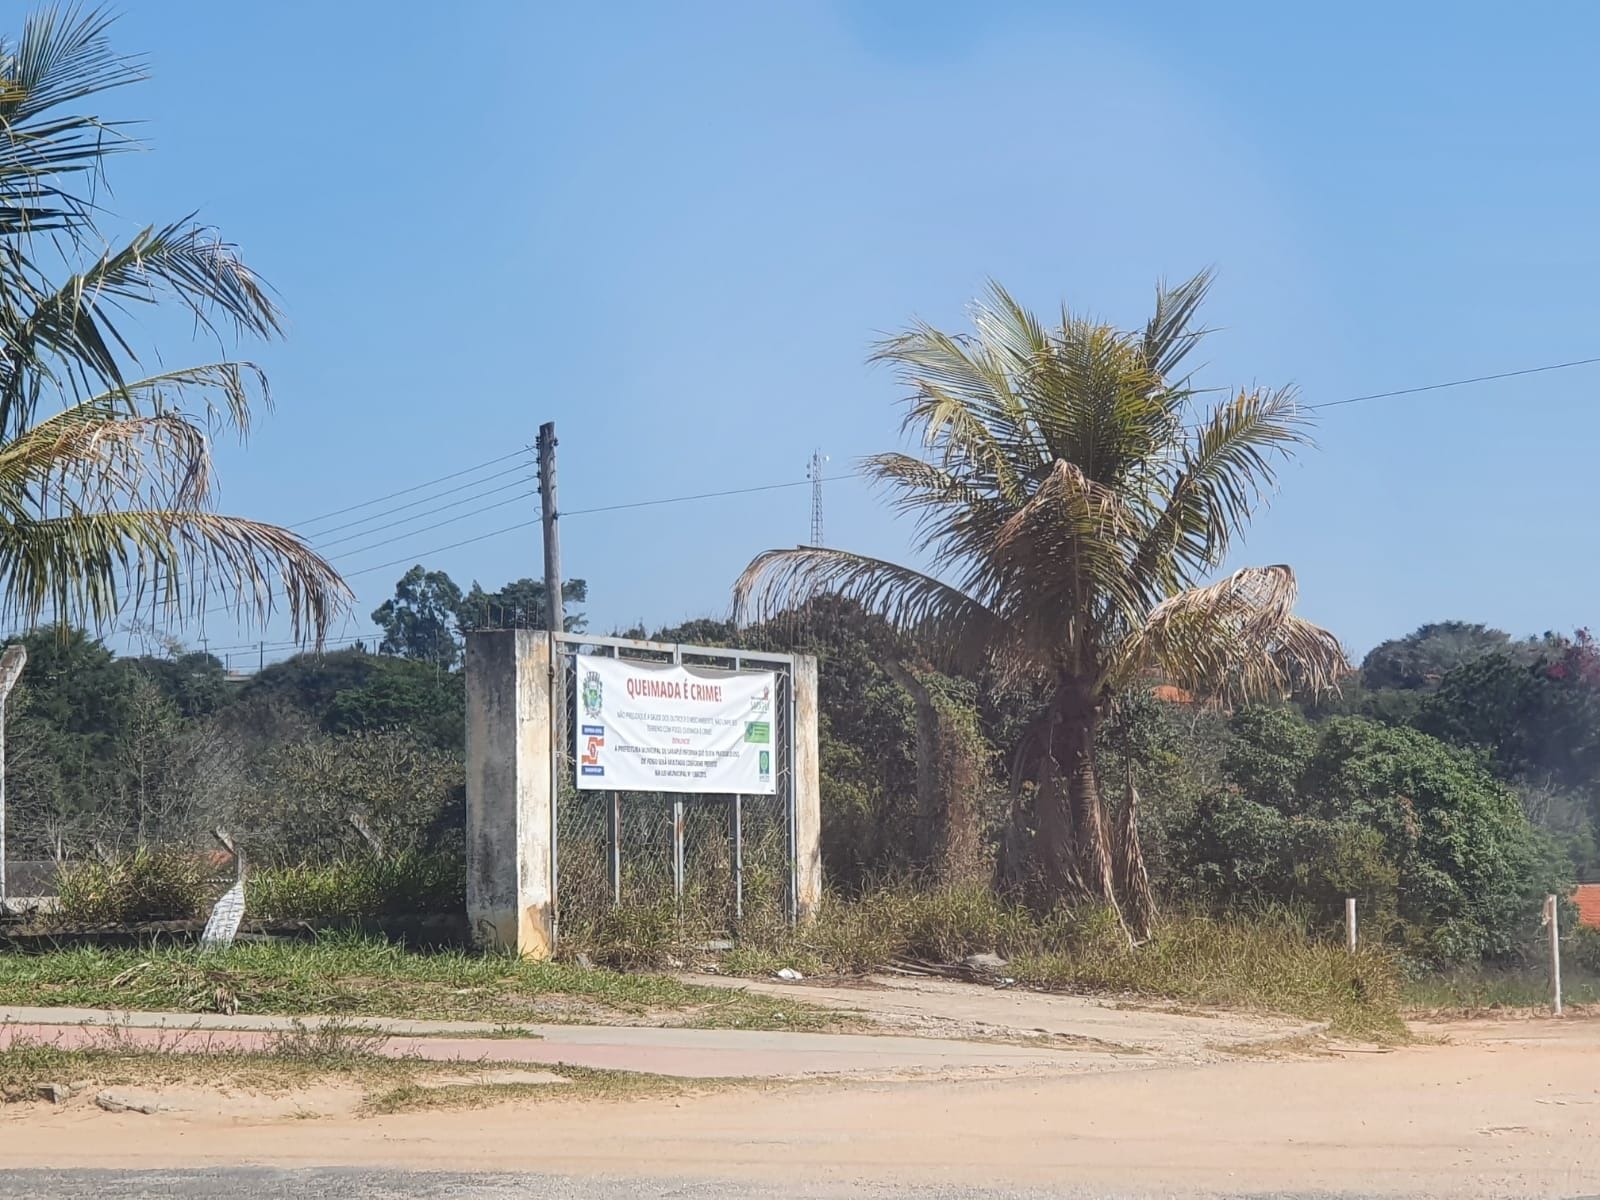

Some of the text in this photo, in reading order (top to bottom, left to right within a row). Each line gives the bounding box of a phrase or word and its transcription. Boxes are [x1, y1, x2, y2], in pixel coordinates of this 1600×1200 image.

[626, 678, 722, 702] QUEIMADA É CRIME!
